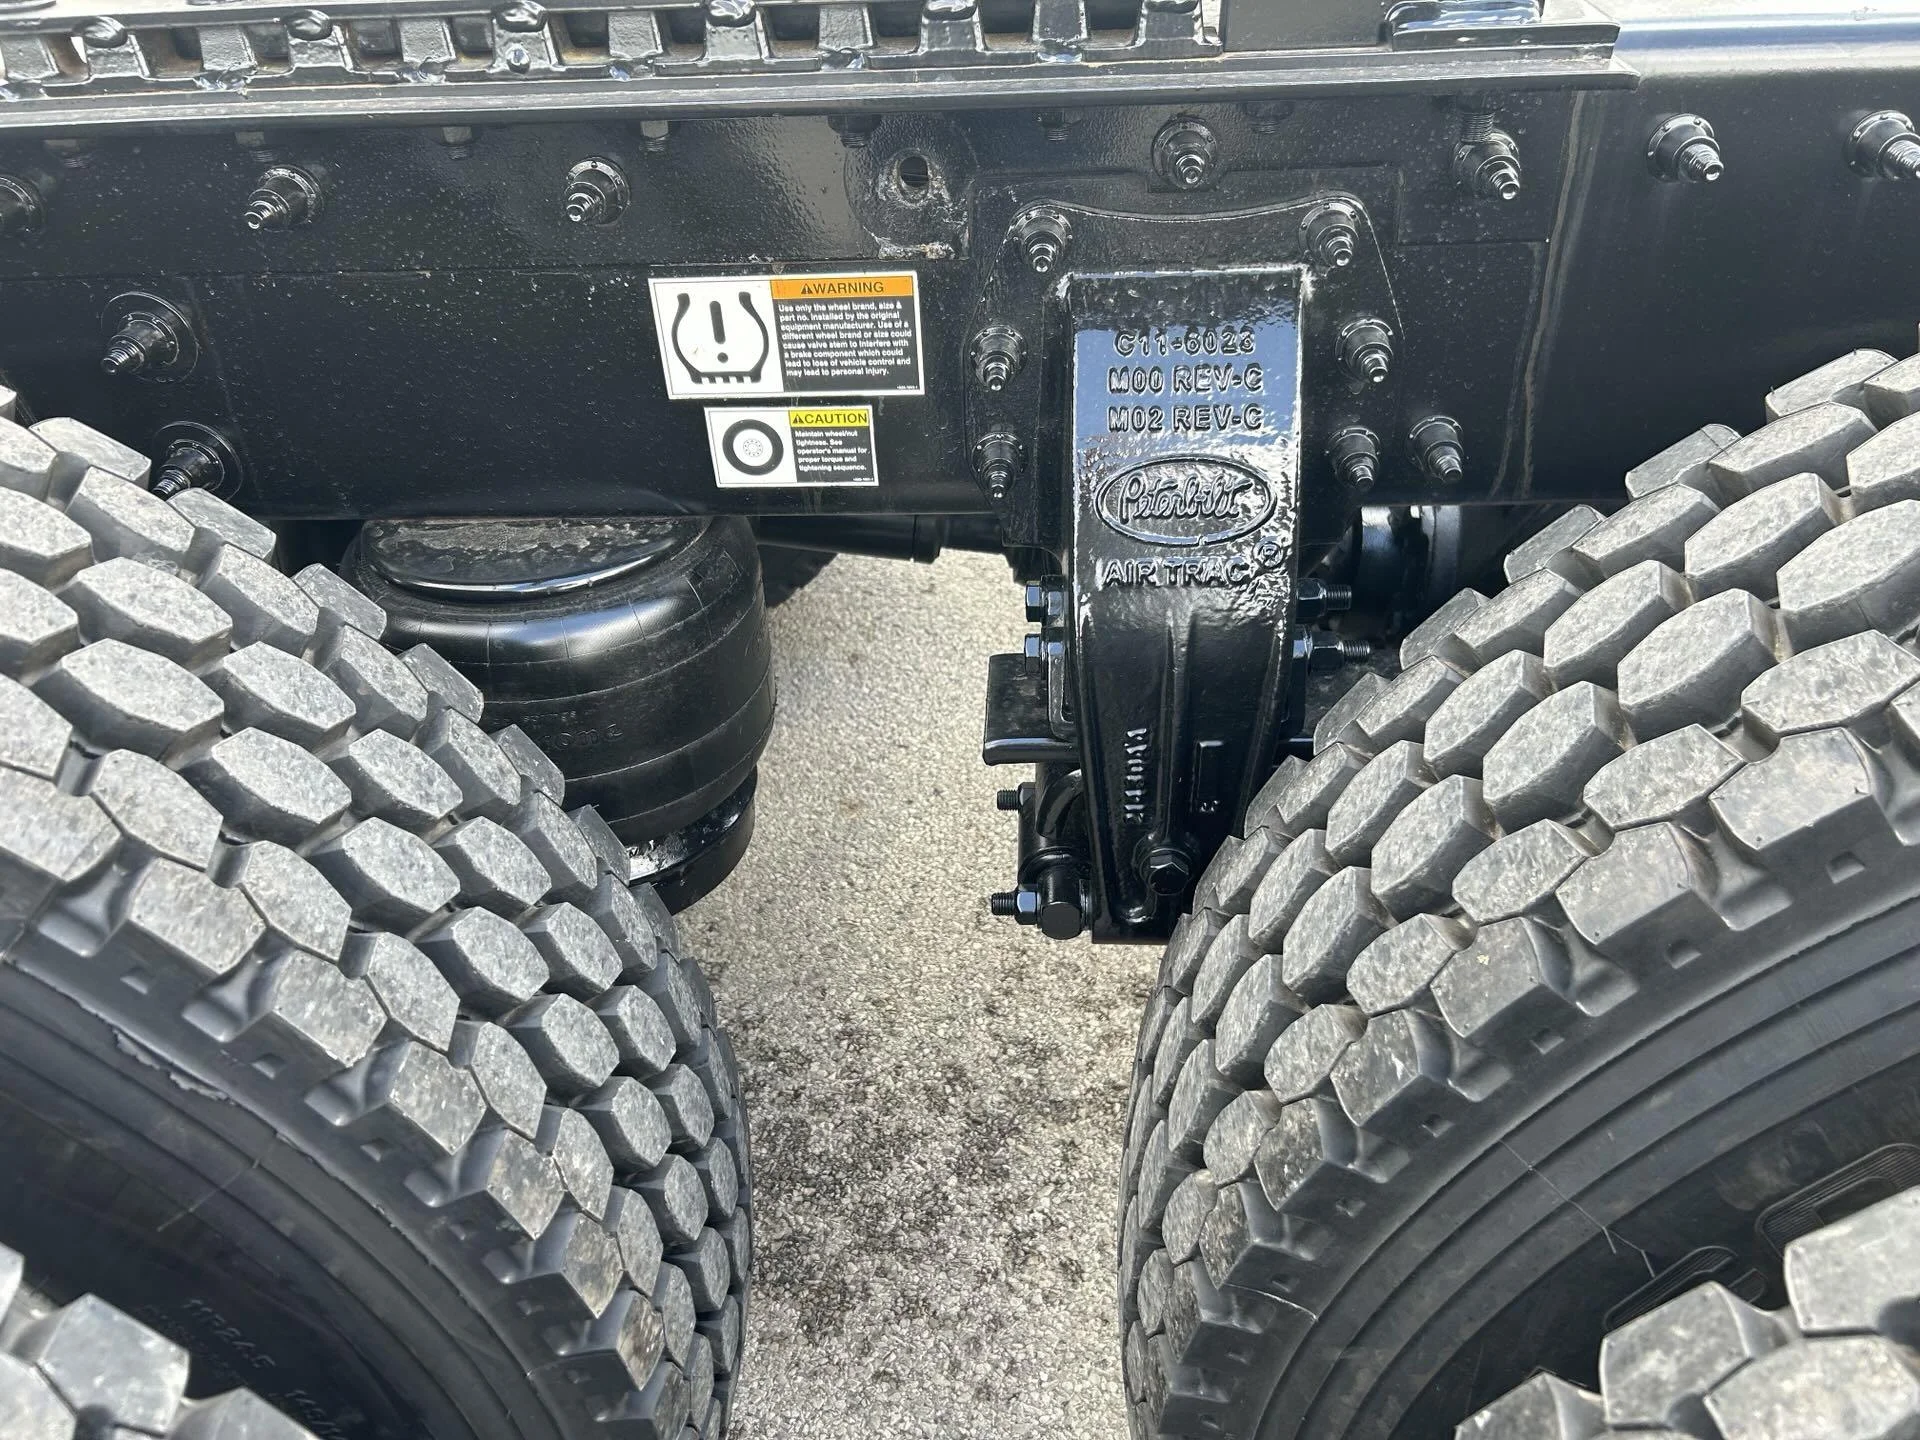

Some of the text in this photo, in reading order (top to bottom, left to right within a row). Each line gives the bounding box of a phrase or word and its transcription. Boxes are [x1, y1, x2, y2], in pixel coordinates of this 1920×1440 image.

[814, 282, 884, 294] WARNING
[778, 304, 793, 312] Use
[795, 304, 812, 313] only
[828, 302, 850, 311] wheel
[852, 302, 877, 311] brand,
[896, 301, 902, 309] &
[780, 314, 796, 322] part
[811, 312, 843, 320] installed
[845, 312, 855, 321] by
[871, 311, 900, 321] original
[781, 322, 821, 332] equipment
[782, 332, 814, 340] different
[816, 331, 838, 339] wheel
[874, 330, 889, 338] size
[829, 340, 848, 348] stem
[859, 339, 892, 347] interfere
[790, 350, 812, 358] brake
[814, 350, 856, 358] component
[882, 348, 903, 356] could
[839, 358, 866, 366] vehicle
[896, 357, 911, 365] and
[787, 367, 889, 377] may lead to personal injury.
[1108, 362, 1264, 395] M00 REV-C
[805, 413, 867, 424] CAUTION
[1108, 403, 1264, 433] M02 REV-C
[1120, 472, 1253, 524] Peterbilt
[1103, 558, 1157, 587] AIR
